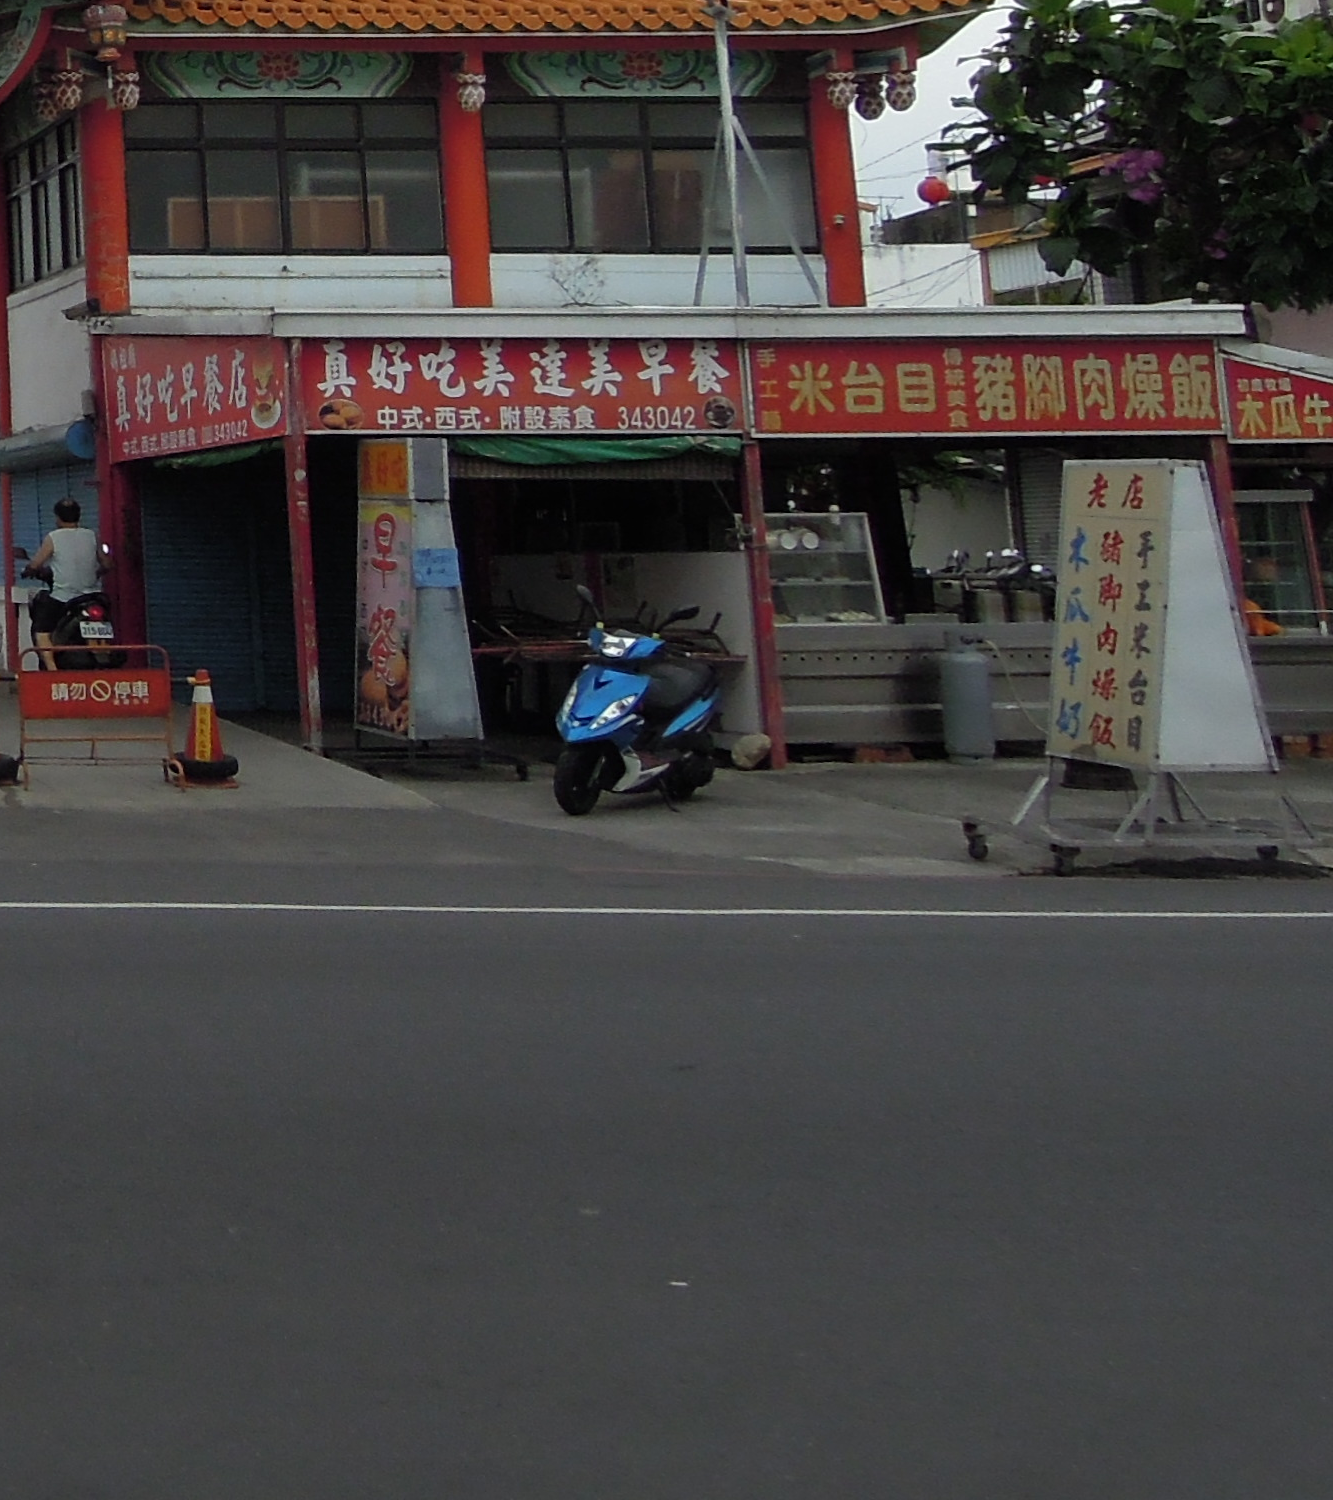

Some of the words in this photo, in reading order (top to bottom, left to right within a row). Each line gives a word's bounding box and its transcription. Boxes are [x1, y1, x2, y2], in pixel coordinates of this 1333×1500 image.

[115, 349, 247, 433] 真好吃早餐店
[317, 339, 730, 398] 真好吃美達美早餐
[787, 361, 937, 416] 米台目
[618, 406, 696, 430] 343042
[1236, 393, 1332, 437] 木瓜牛
[51, 682, 87, 701] 請勿
[114, 681, 149, 699] 停車
